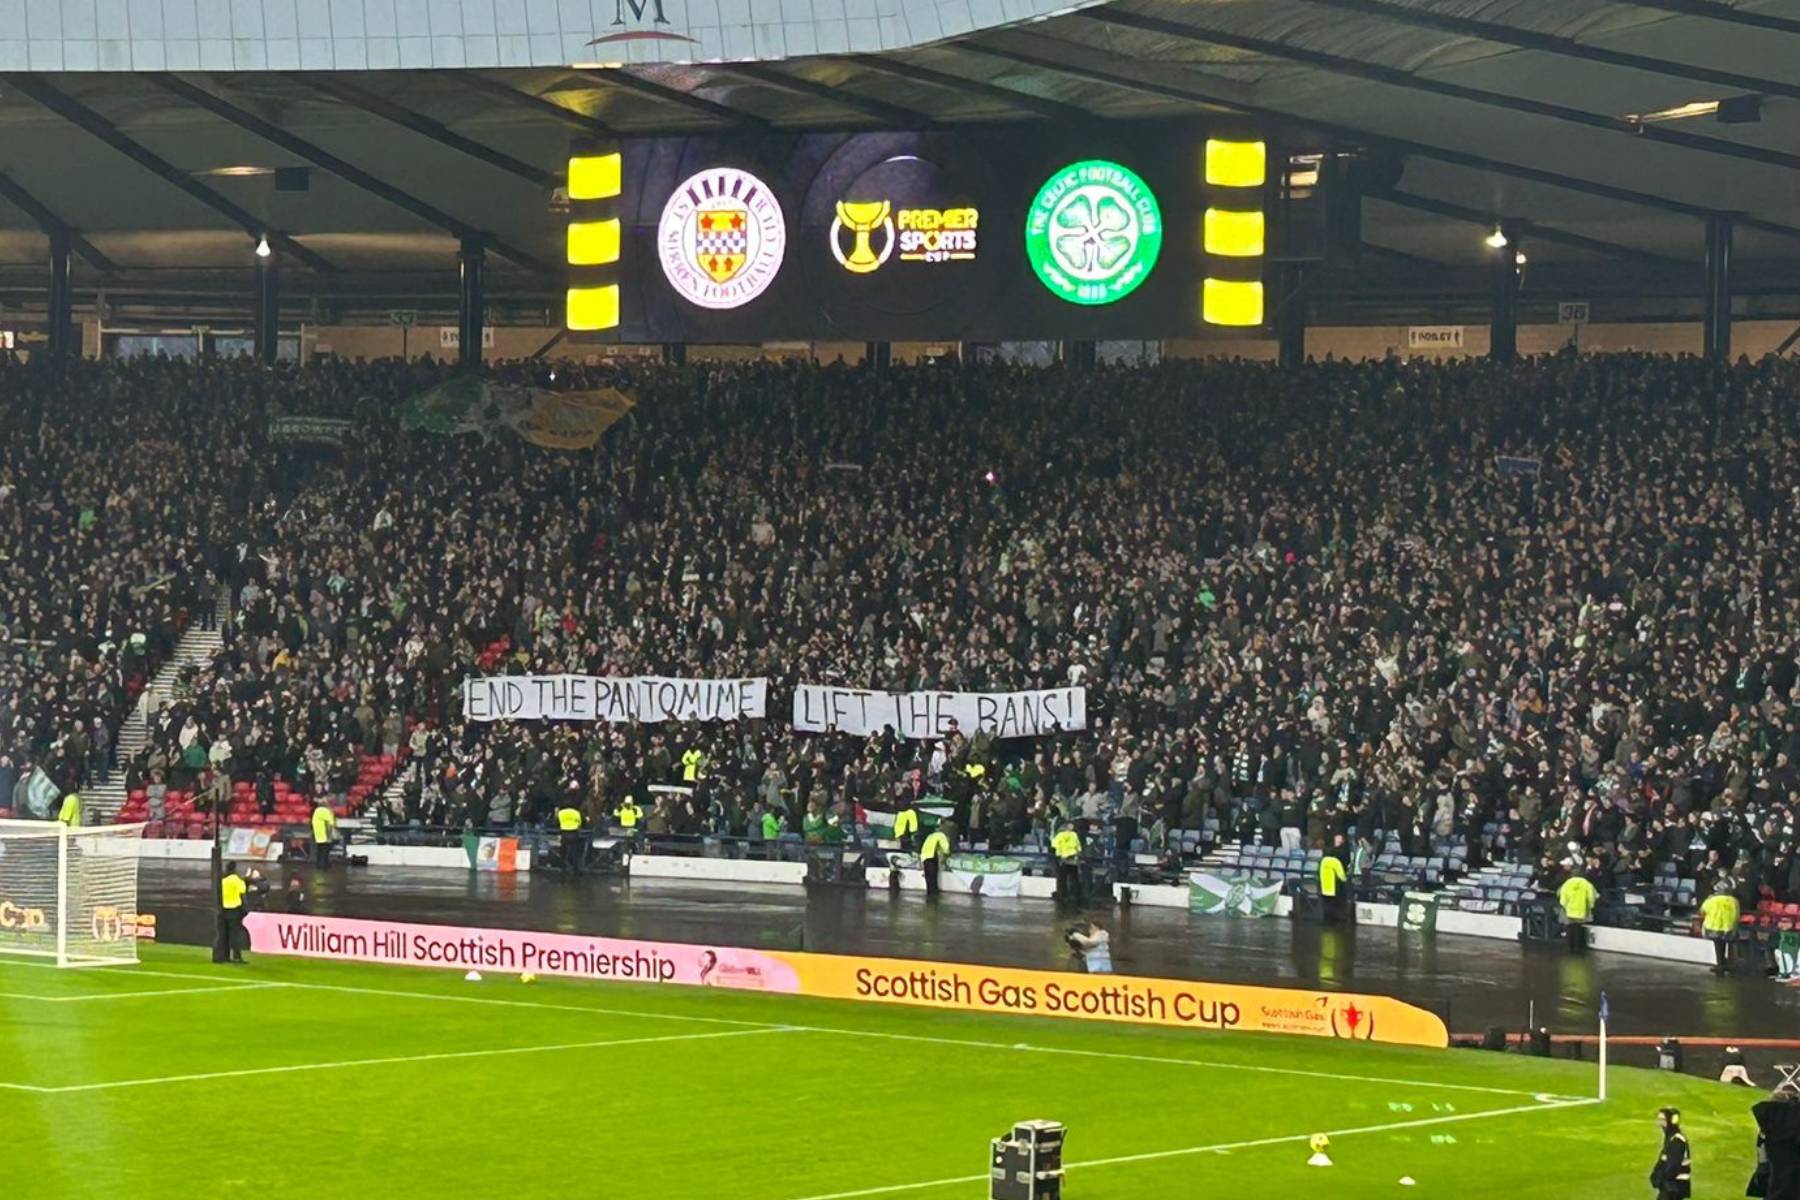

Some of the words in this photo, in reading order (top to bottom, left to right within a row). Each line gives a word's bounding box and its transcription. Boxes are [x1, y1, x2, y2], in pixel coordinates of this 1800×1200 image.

[898, 208, 979, 230] PREMIER
[900, 231, 977, 251] SPORTS
[468, 680, 524, 716] END
[532, 679, 586, 714] THE
[595, 680, 755, 717] PANTOMIME
[804, 689, 872, 729] LIFT
[887, 691, 953, 735] THE
[977, 690, 1073, 738] BANS!
[278, 923, 367, 956] William
[374, 930, 407, 959] Hill
[413, 935, 515, 967] Scottish
[522, 942, 675, 982] Premiership
[856, 969, 971, 1004] Scottish
[978, 978, 1037, 1009] Gas
[1045, 983, 1166, 1019] Scottish
[1174, 992, 1240, 1029] Cup
